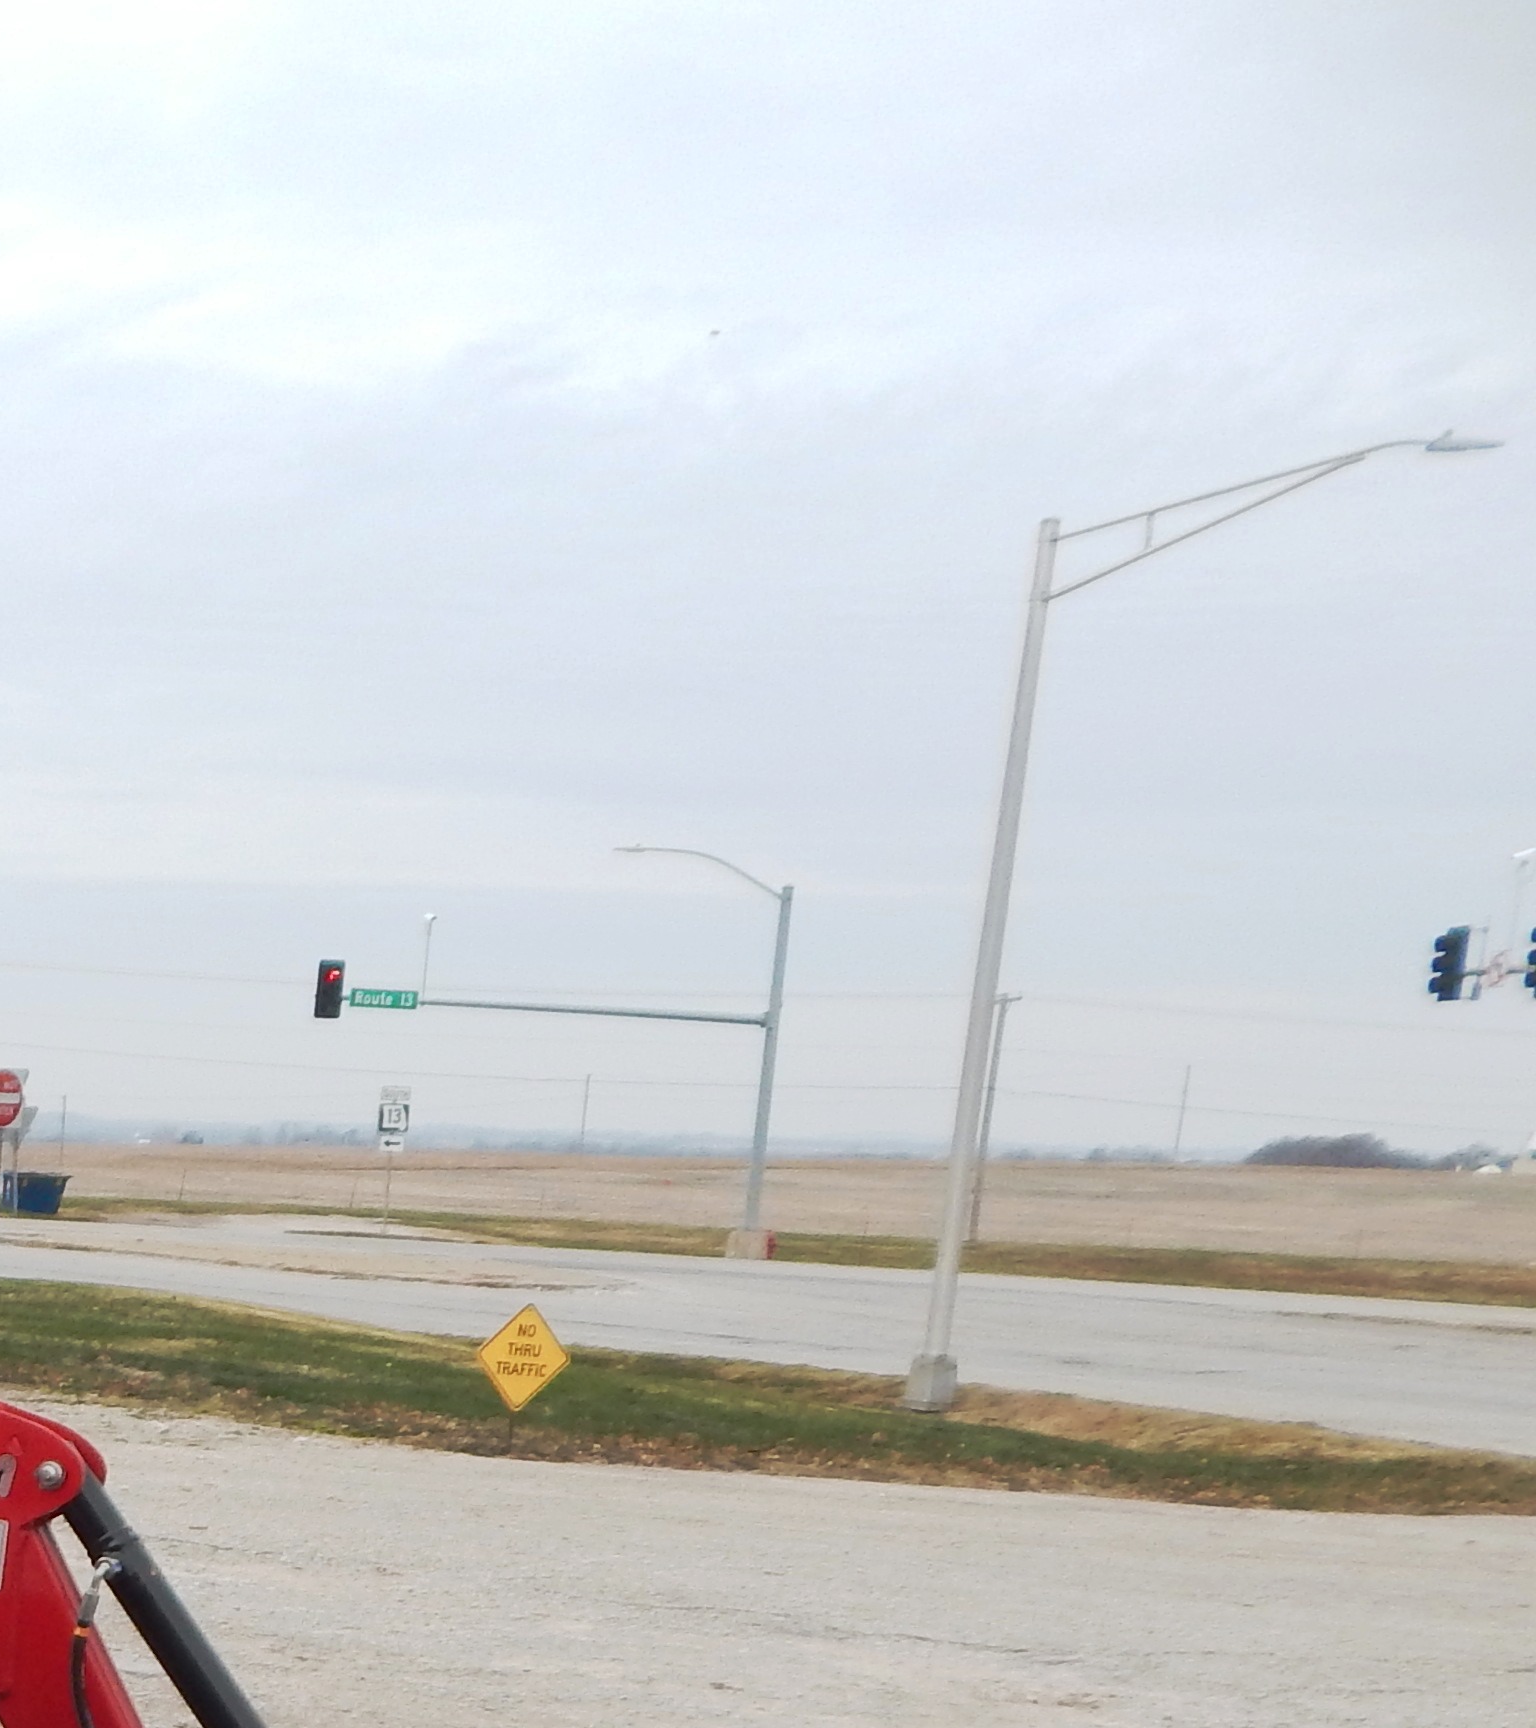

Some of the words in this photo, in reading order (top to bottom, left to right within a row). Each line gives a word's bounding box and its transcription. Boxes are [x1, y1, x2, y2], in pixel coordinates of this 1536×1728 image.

[355, 991, 393, 1006] Route
[400, 992, 414, 1006] 13
[387, 1108, 402, 1124] 13
[517, 1324, 537, 1337] NO
[508, 1342, 542, 1357] THRU
[496, 1361, 547, 1377] TRAFFIC
